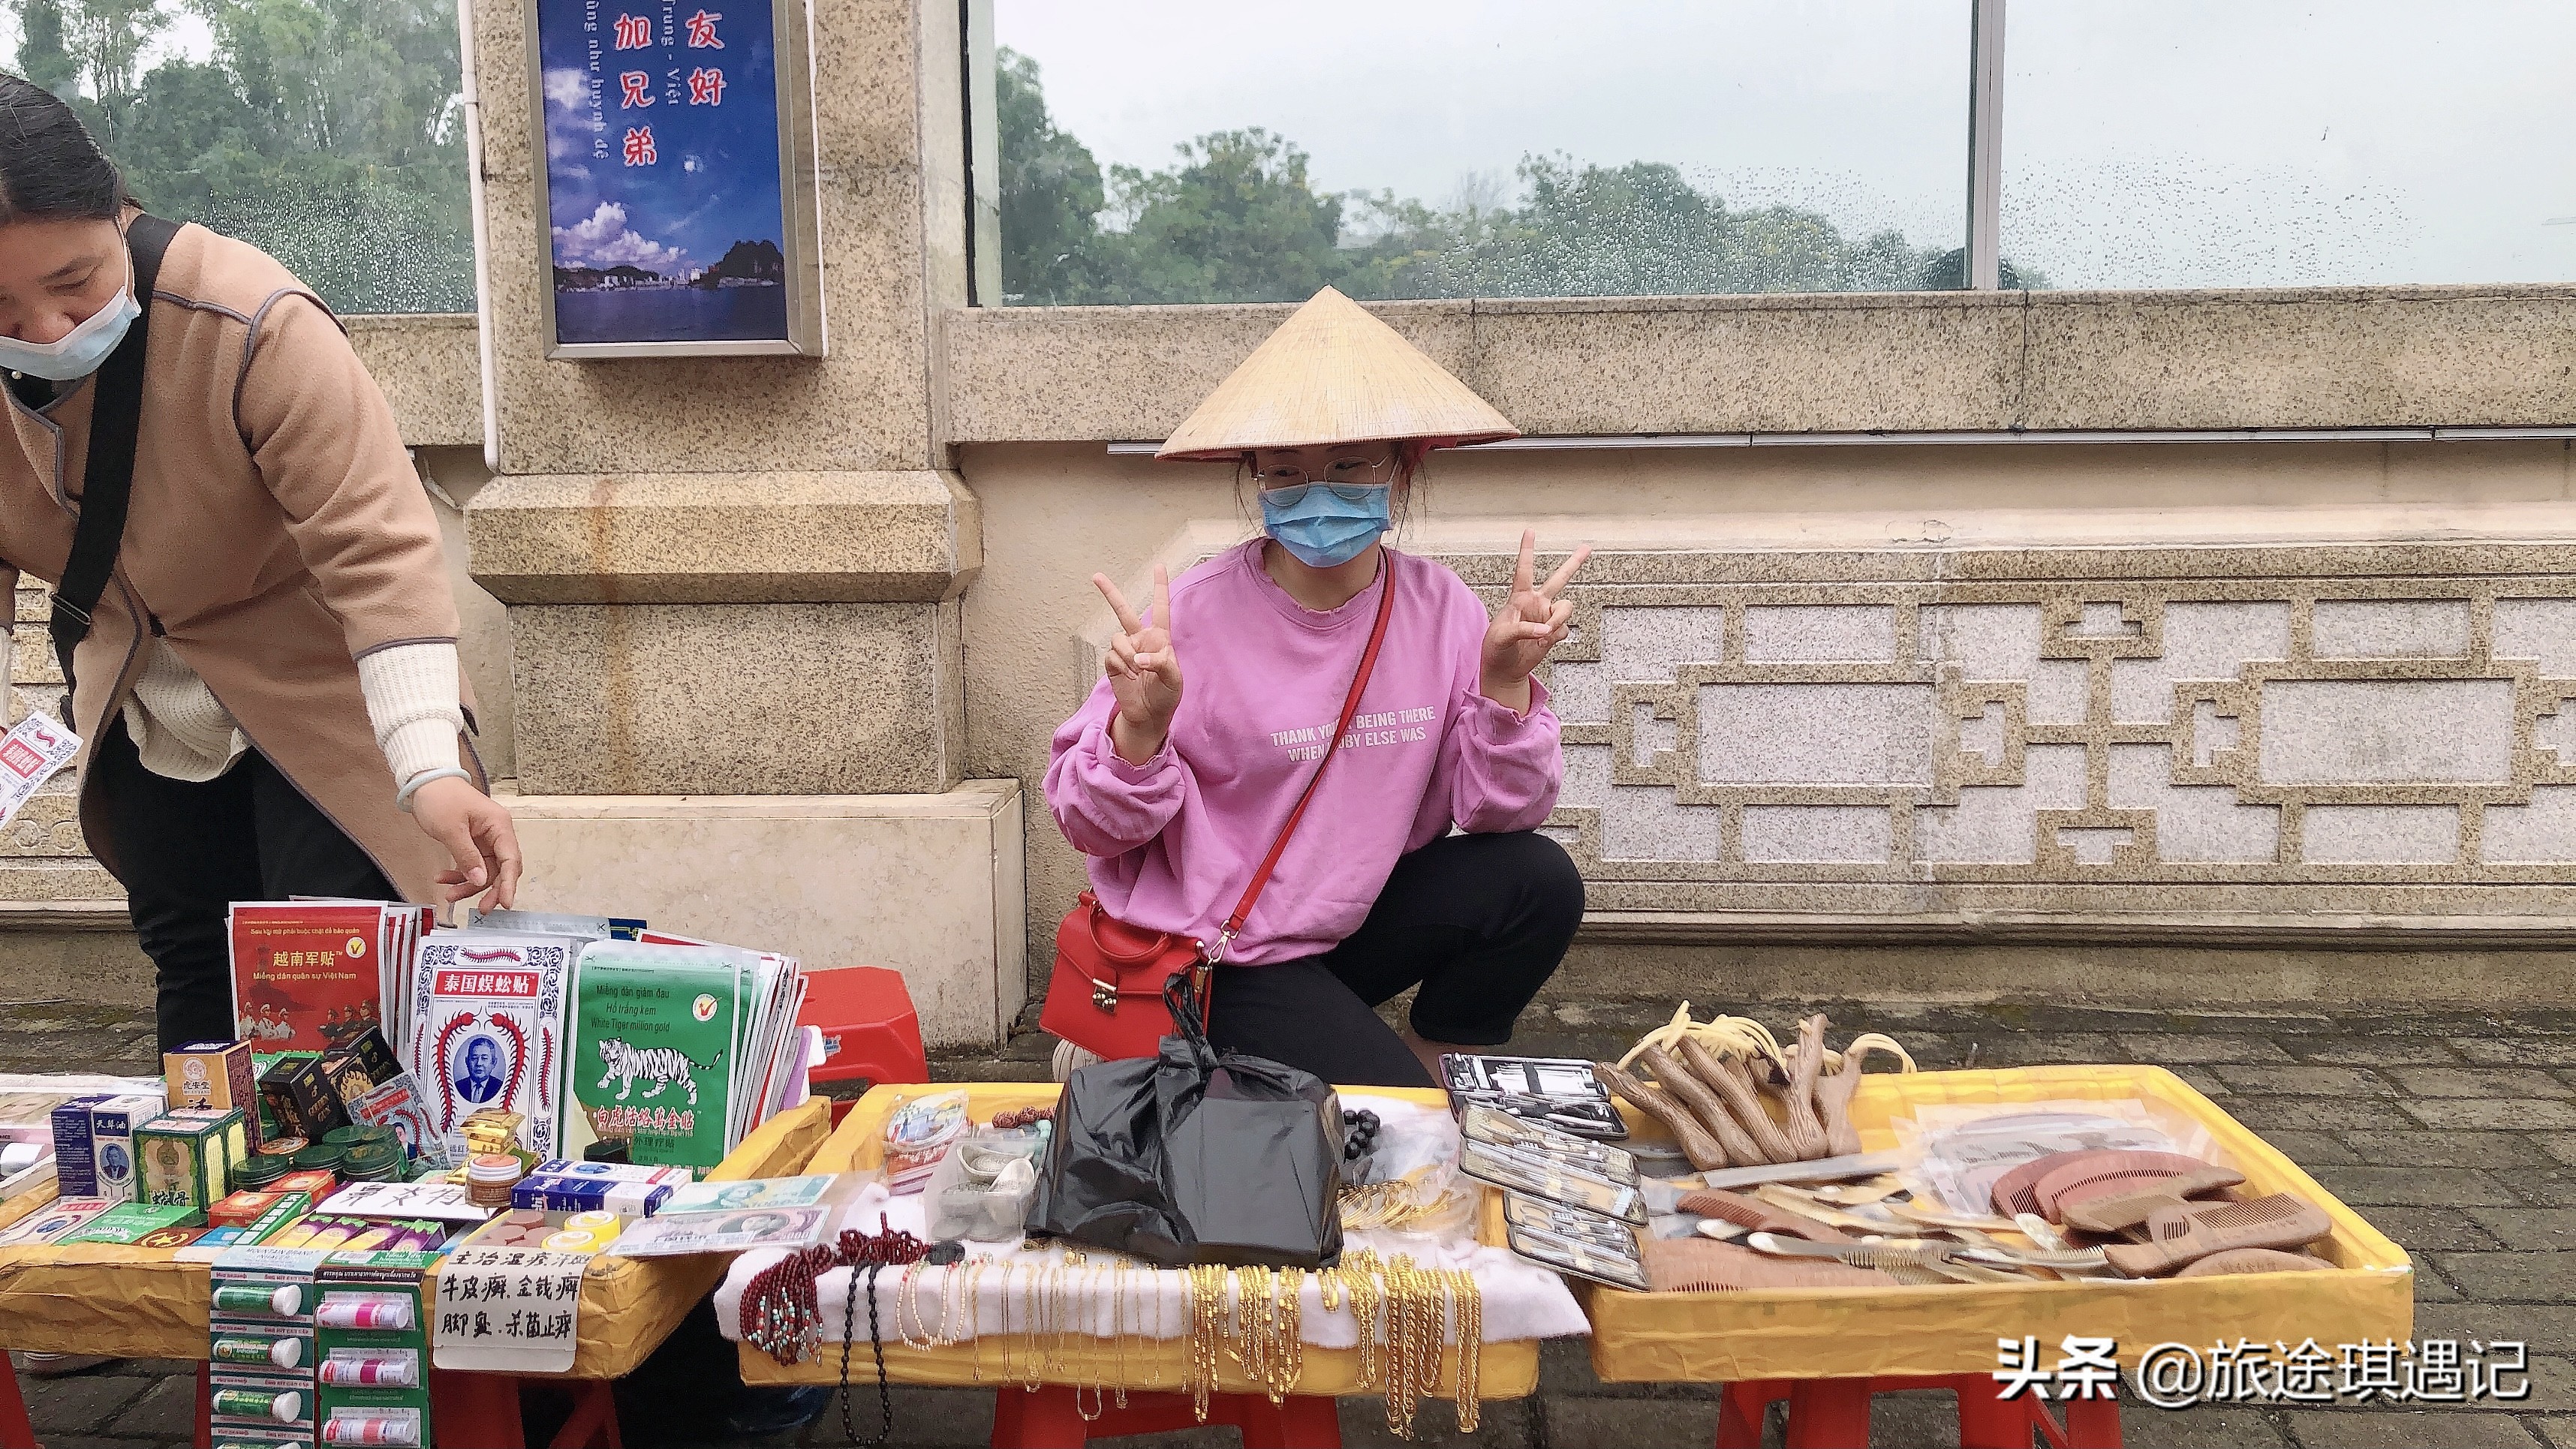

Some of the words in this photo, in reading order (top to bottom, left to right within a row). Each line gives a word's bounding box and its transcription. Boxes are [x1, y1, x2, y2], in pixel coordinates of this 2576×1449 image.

[685, 9, 727, 107] 友好
[612, 12, 658, 167] 加兄弟
[1271, 728, 1317, 747] THANK
[1356, 711, 1397, 729] BEING
[1398, 706, 1436, 724] THERE
[1287, 747, 1325, 762] WHEN
[1365, 731, 1397, 747] ELSE
[1401, 726, 1427, 741] WAS
[273, 950, 336, 967] 越南军贴
[338, 972, 357, 980] Nam
[444, 973, 529, 994] 泰国蜈蚣贴
[639, 1006, 657, 1015] kem
[591, 1017, 610, 1030] White
[611, 1018, 629, 1031] Tiger
[630, 1019, 653, 1032] million
[655, 1021, 671, 1033] gold
